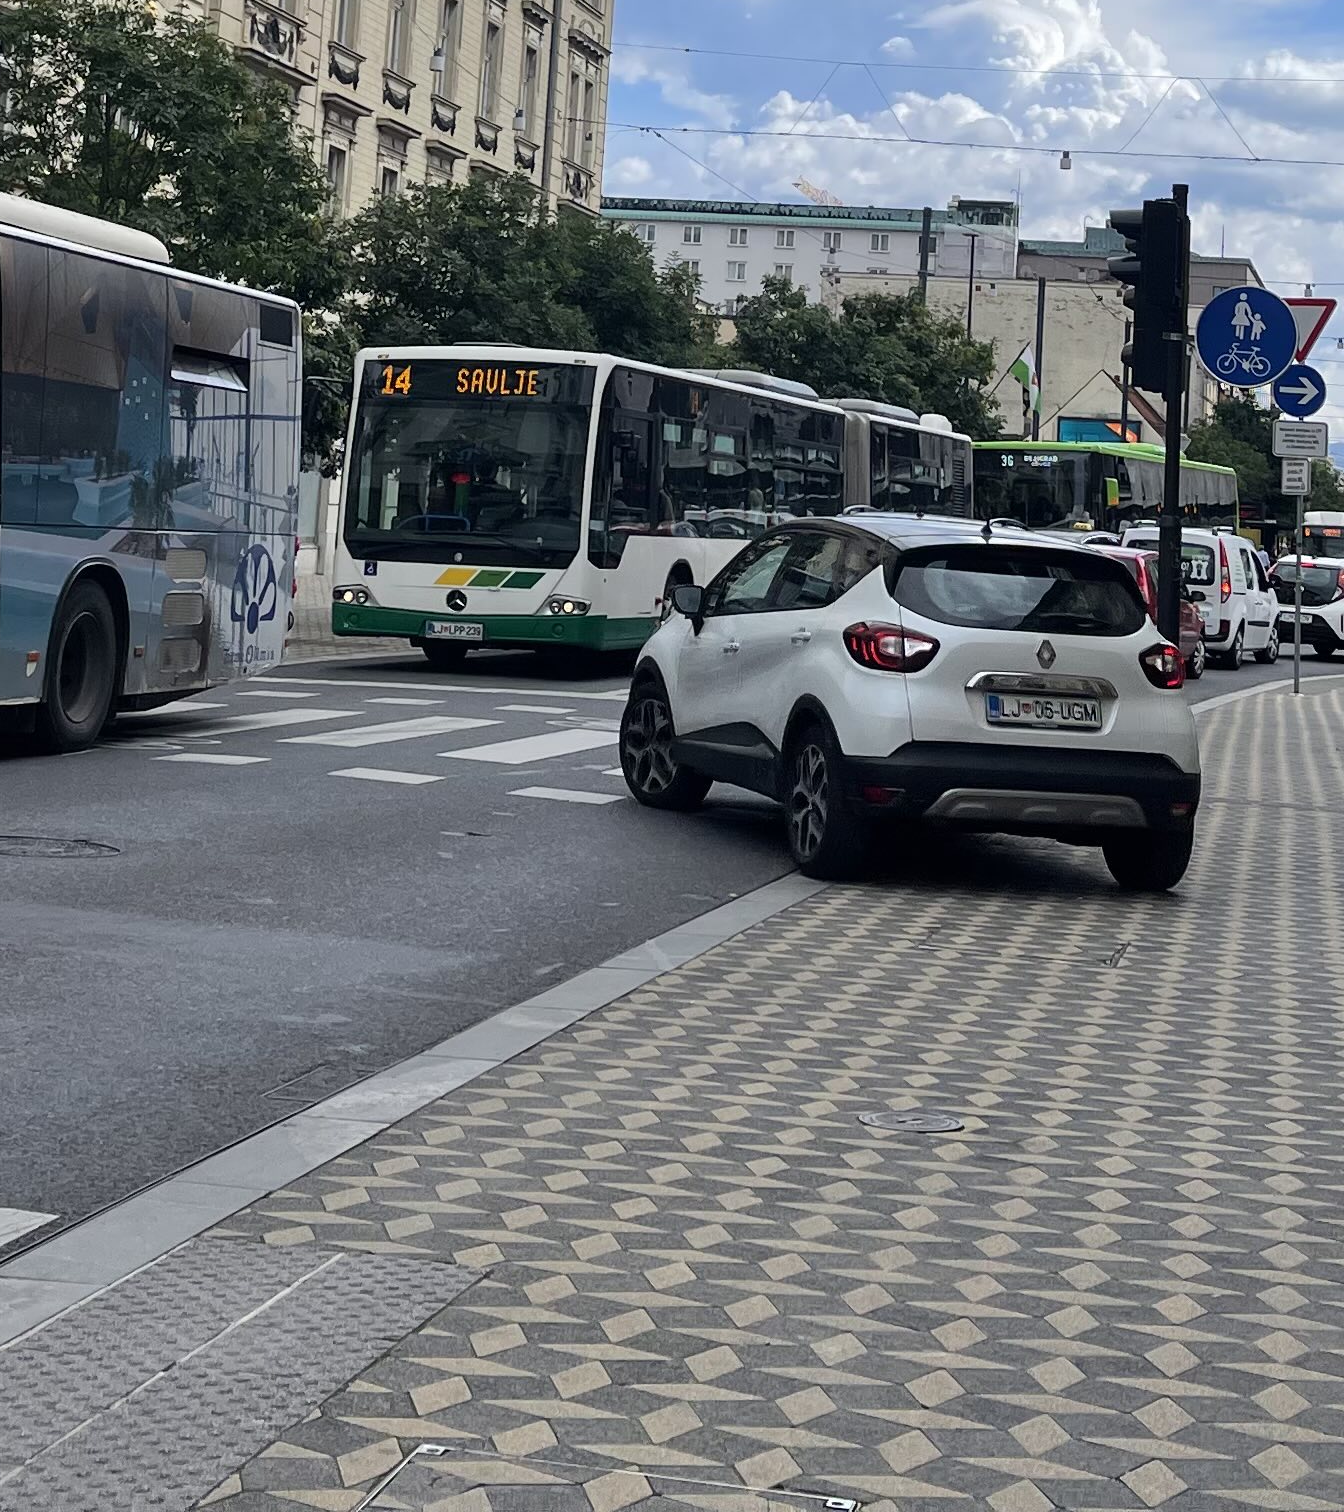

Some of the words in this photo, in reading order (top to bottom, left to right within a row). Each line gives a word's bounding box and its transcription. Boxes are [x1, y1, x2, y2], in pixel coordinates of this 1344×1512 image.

[381, 364, 412, 395] 14
[456, 367, 540, 396] SAVLJE
[1001, 454, 1014, 467] 3G
[1000, 697, 1021, 718] LJ
